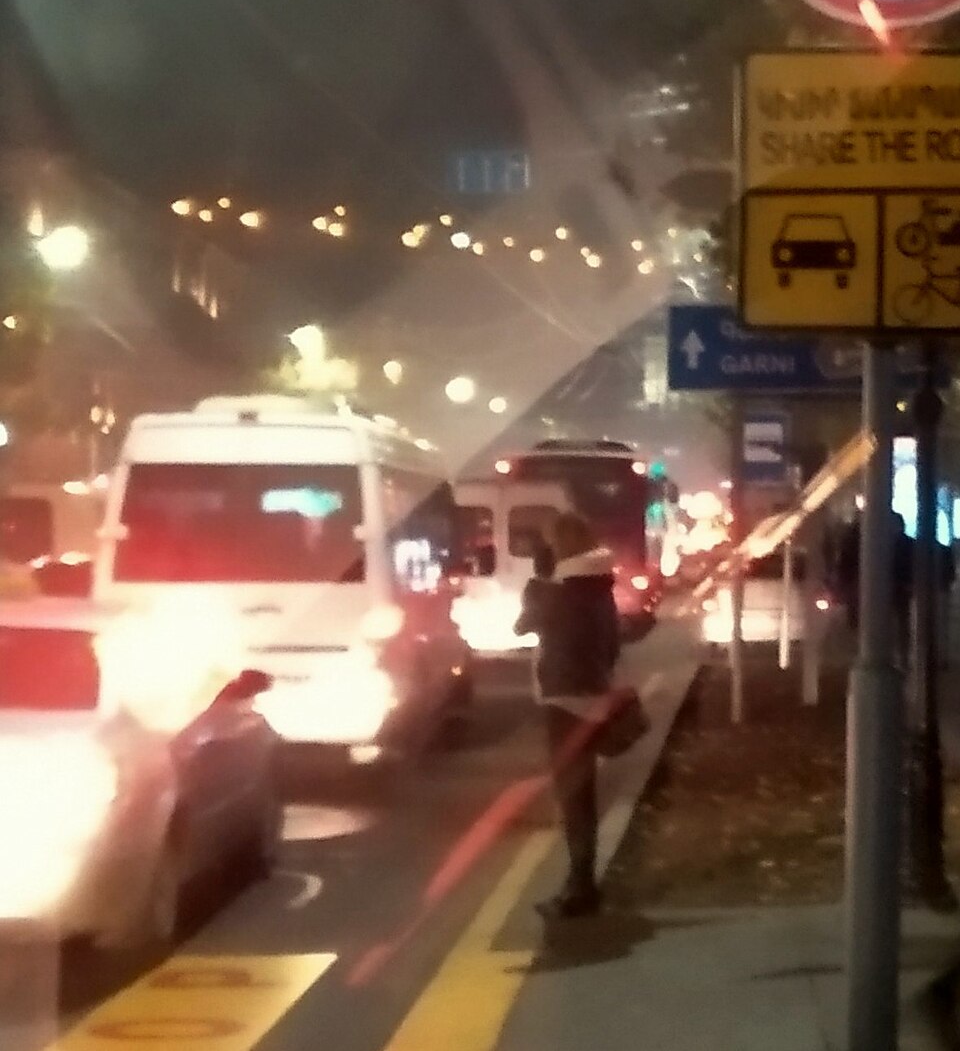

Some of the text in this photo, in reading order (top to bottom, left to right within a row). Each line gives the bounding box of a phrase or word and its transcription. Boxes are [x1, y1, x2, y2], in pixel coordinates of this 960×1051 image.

[759, 130, 856, 165] SHARE
[862, 129, 917, 163] THE
[720, 354, 795, 375] GARNI
